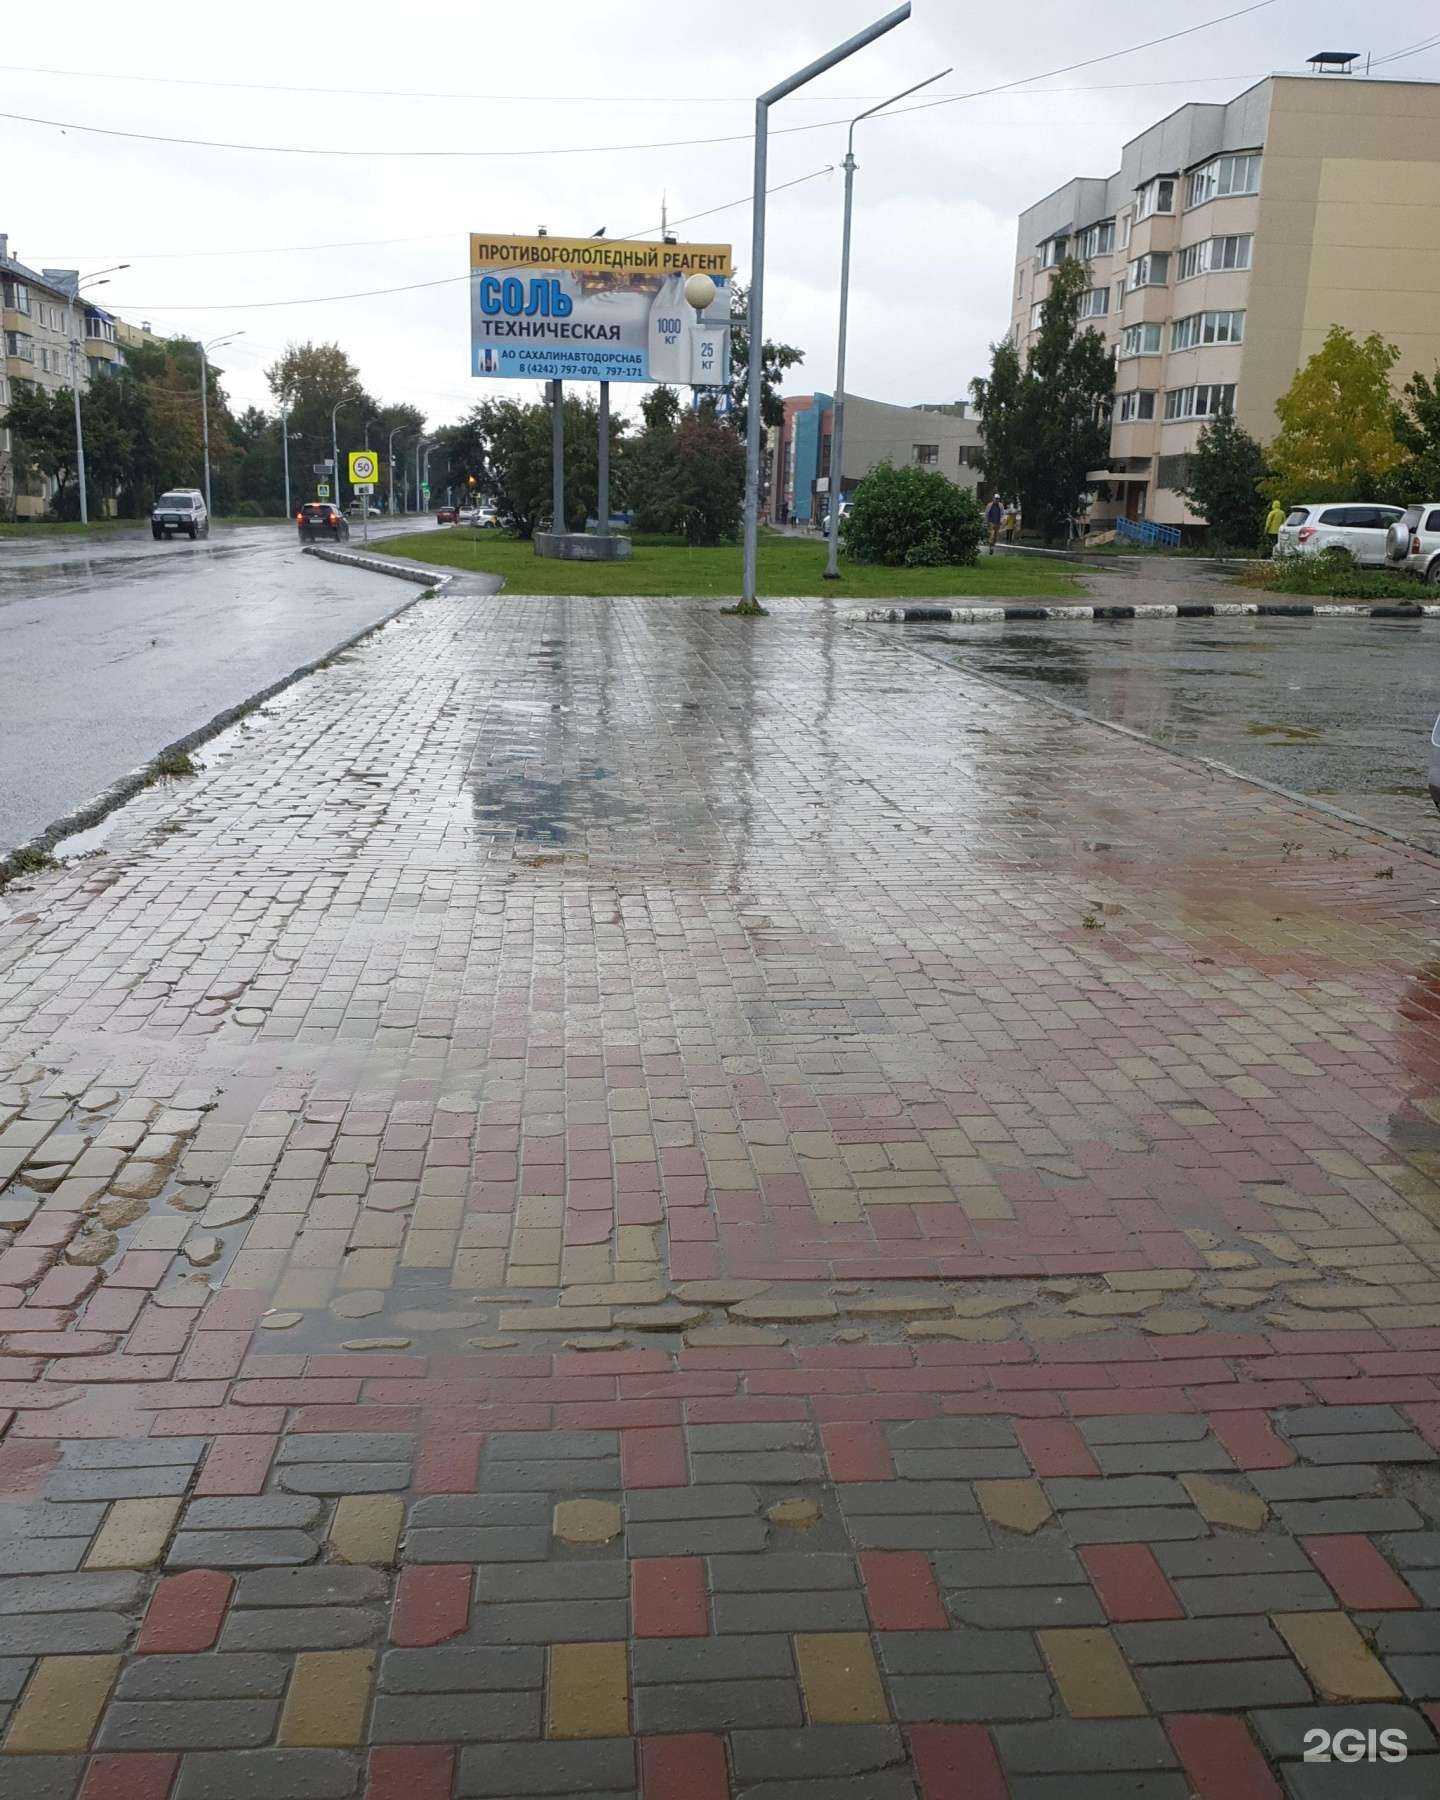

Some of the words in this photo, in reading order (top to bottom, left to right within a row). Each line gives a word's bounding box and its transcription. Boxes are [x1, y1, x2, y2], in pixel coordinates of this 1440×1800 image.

[479, 244, 658, 269] ПРОТИВОГОЛОЛЕДНЫЙ
[663, 252, 727, 270] РЕАГЕНТ
[480, 277, 572, 317] СОЛЬ
[482, 320, 621, 341] ТЕХНИЧЕСКАЯ
[657, 318, 681, 334] 1000
[501, 350, 516, 360] АО
[518, 350, 643, 364] САХАЛИНАВТОДОРСНАБ
[701, 342, 714, 358] 25
[519, 364, 526, 373] 8
[527, 363, 559, 376] (4242)
[606, 367, 643, 377] 797-171
[357, 463, 370, 472] 50
